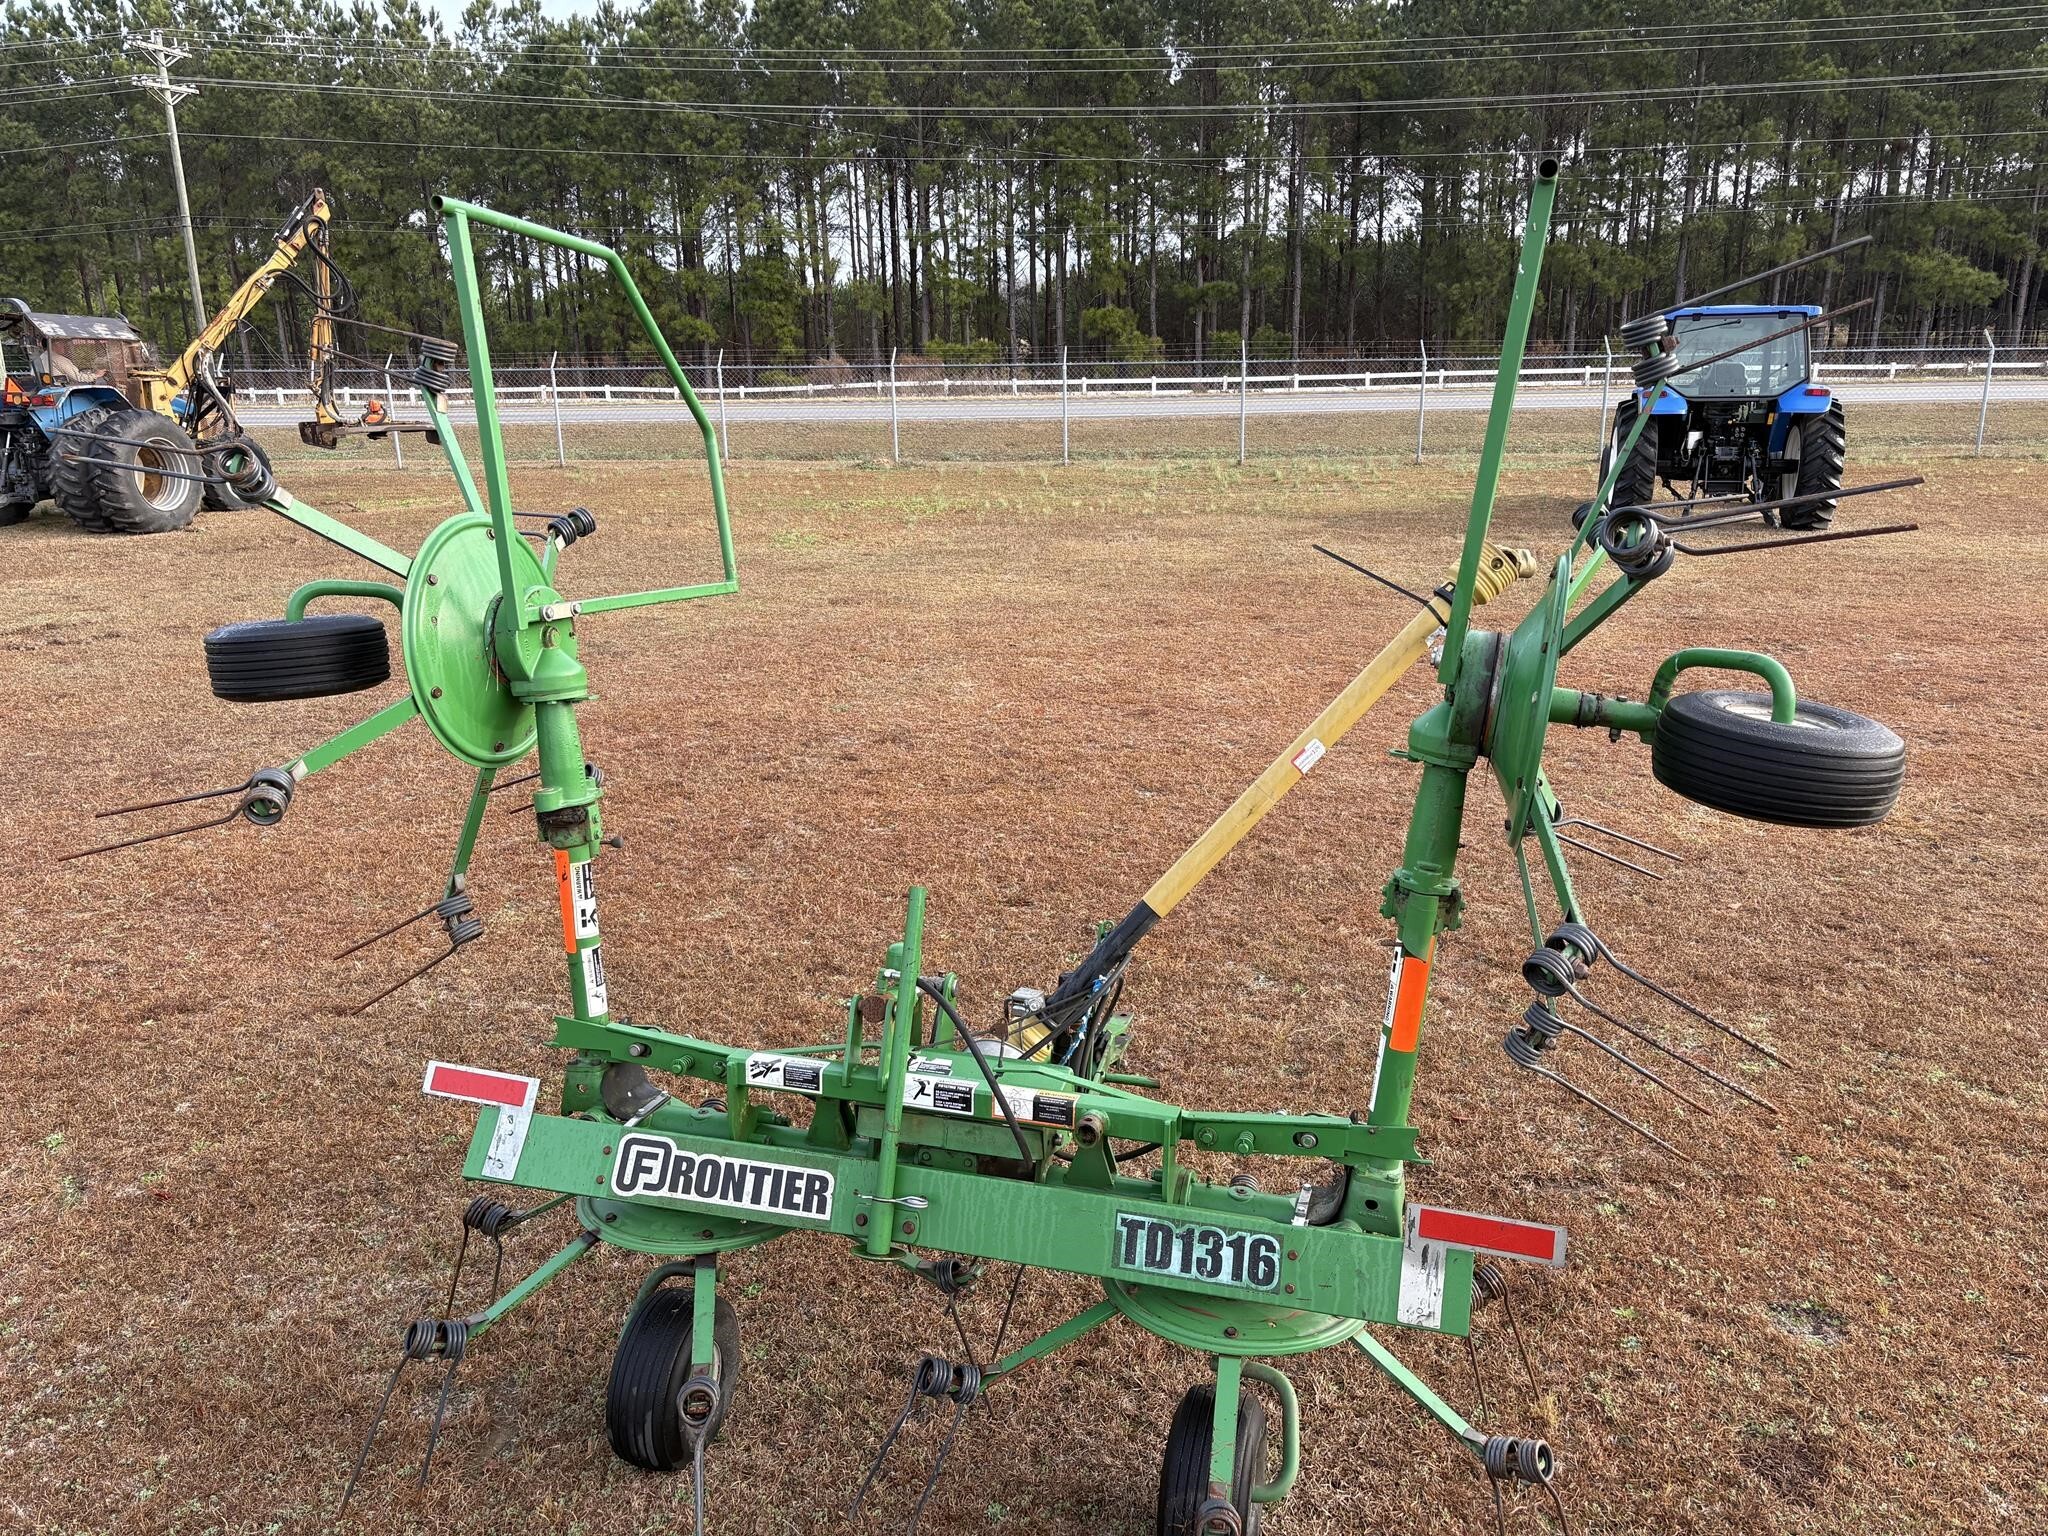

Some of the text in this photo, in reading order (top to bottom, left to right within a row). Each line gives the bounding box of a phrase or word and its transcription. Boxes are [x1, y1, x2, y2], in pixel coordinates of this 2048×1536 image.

[575, 866, 583, 895] WARNING
[615, 1137, 830, 1215] FRONTIER
[1120, 1217, 1277, 1287] TD1316
